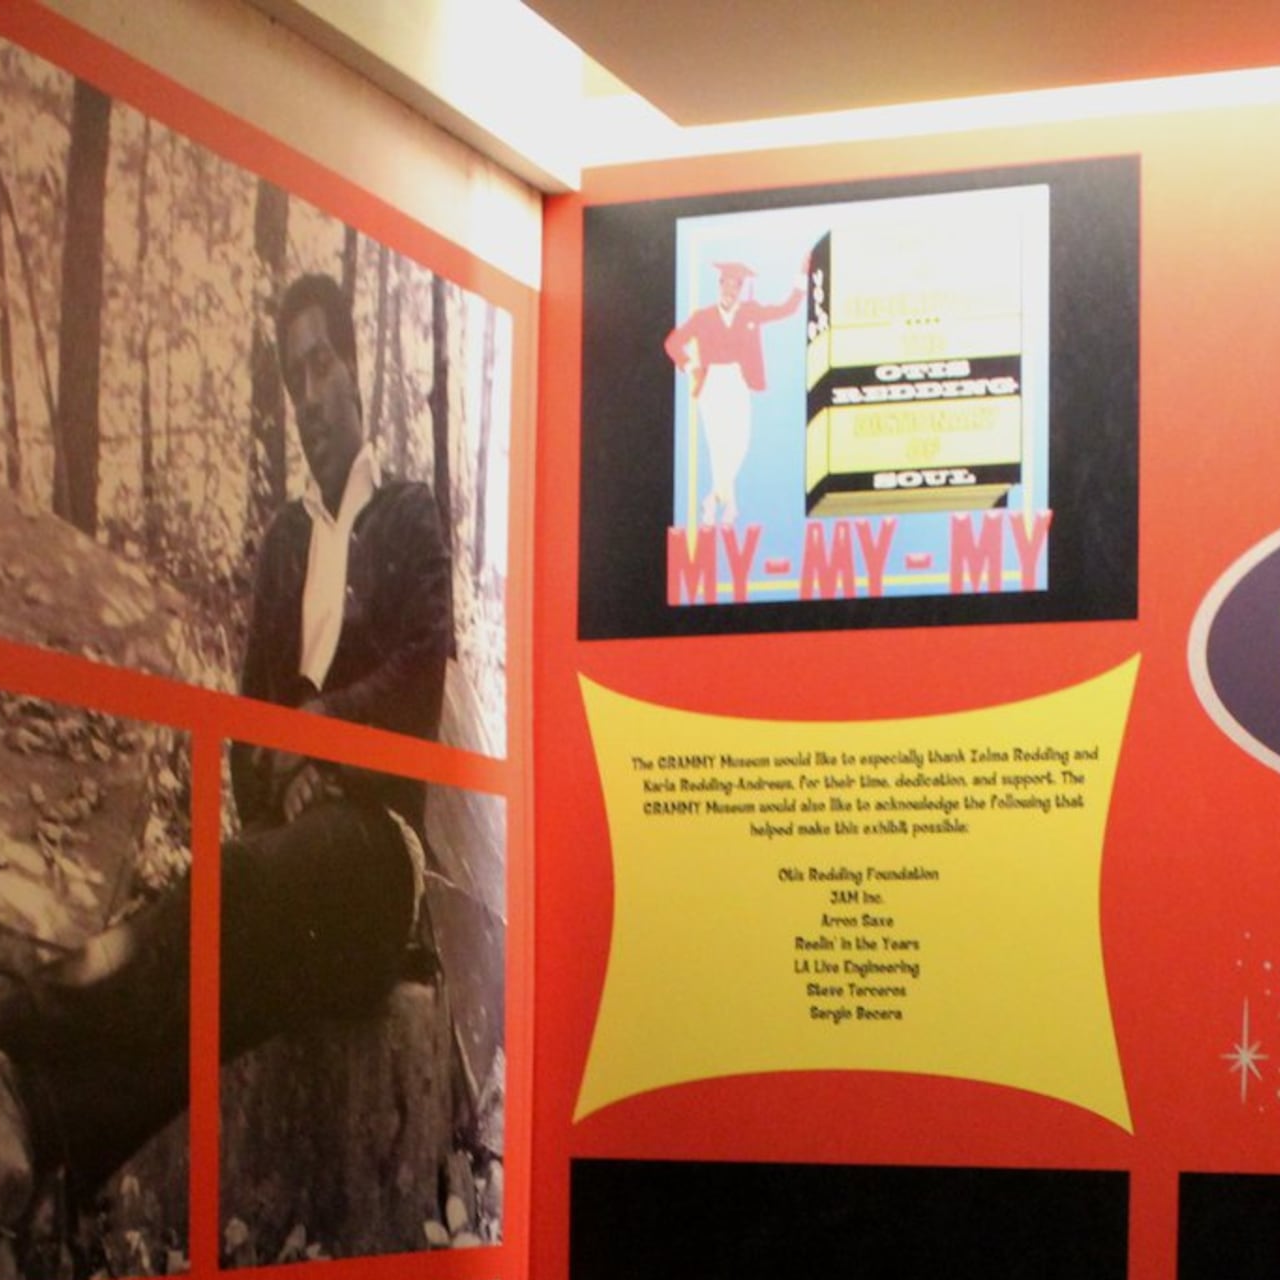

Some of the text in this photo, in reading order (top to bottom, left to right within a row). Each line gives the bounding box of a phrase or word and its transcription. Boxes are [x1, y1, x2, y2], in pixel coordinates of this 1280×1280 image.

[875, 359, 970, 381] OTIS
[831, 376, 1019, 405] REDDING
[872, 468, 977, 490] SOUL
[631, 756, 653, 770] The
[658, 755, 715, 769] GRAMMY
[720, 754, 770, 768] Museum
[774, 752, 810, 767] would
[815, 751, 837, 766] like
[840, 751, 856, 766] to
[860, 748, 924, 769] especially
[928, 748, 965, 763] thank
[1013, 745, 1069, 766] Redding
[1074, 744, 1099, 761] and
[643, 778, 675, 793] Karla
[799, 774, 820, 789] for
[824, 775, 855, 788] their
[972, 771, 996, 786] and
[1061, 769, 1086, 785] The
[643, 793, 1084, 815] GRAMMY Museum would also like to acknowledge the following that
[749, 821, 793, 840] helped
[798, 821, 831, 836] make
[834, 820, 859, 836] this
[863, 819, 908, 835] exhibit
[778, 864, 939, 886] Otis Redding Foundation
[830, 890, 859, 905] JAM
[855, 936, 877, 950] the
[882, 936, 920, 951] Years
[794, 959, 920, 979] LA Live Engineering
[806, 983, 844, 997] Steve
